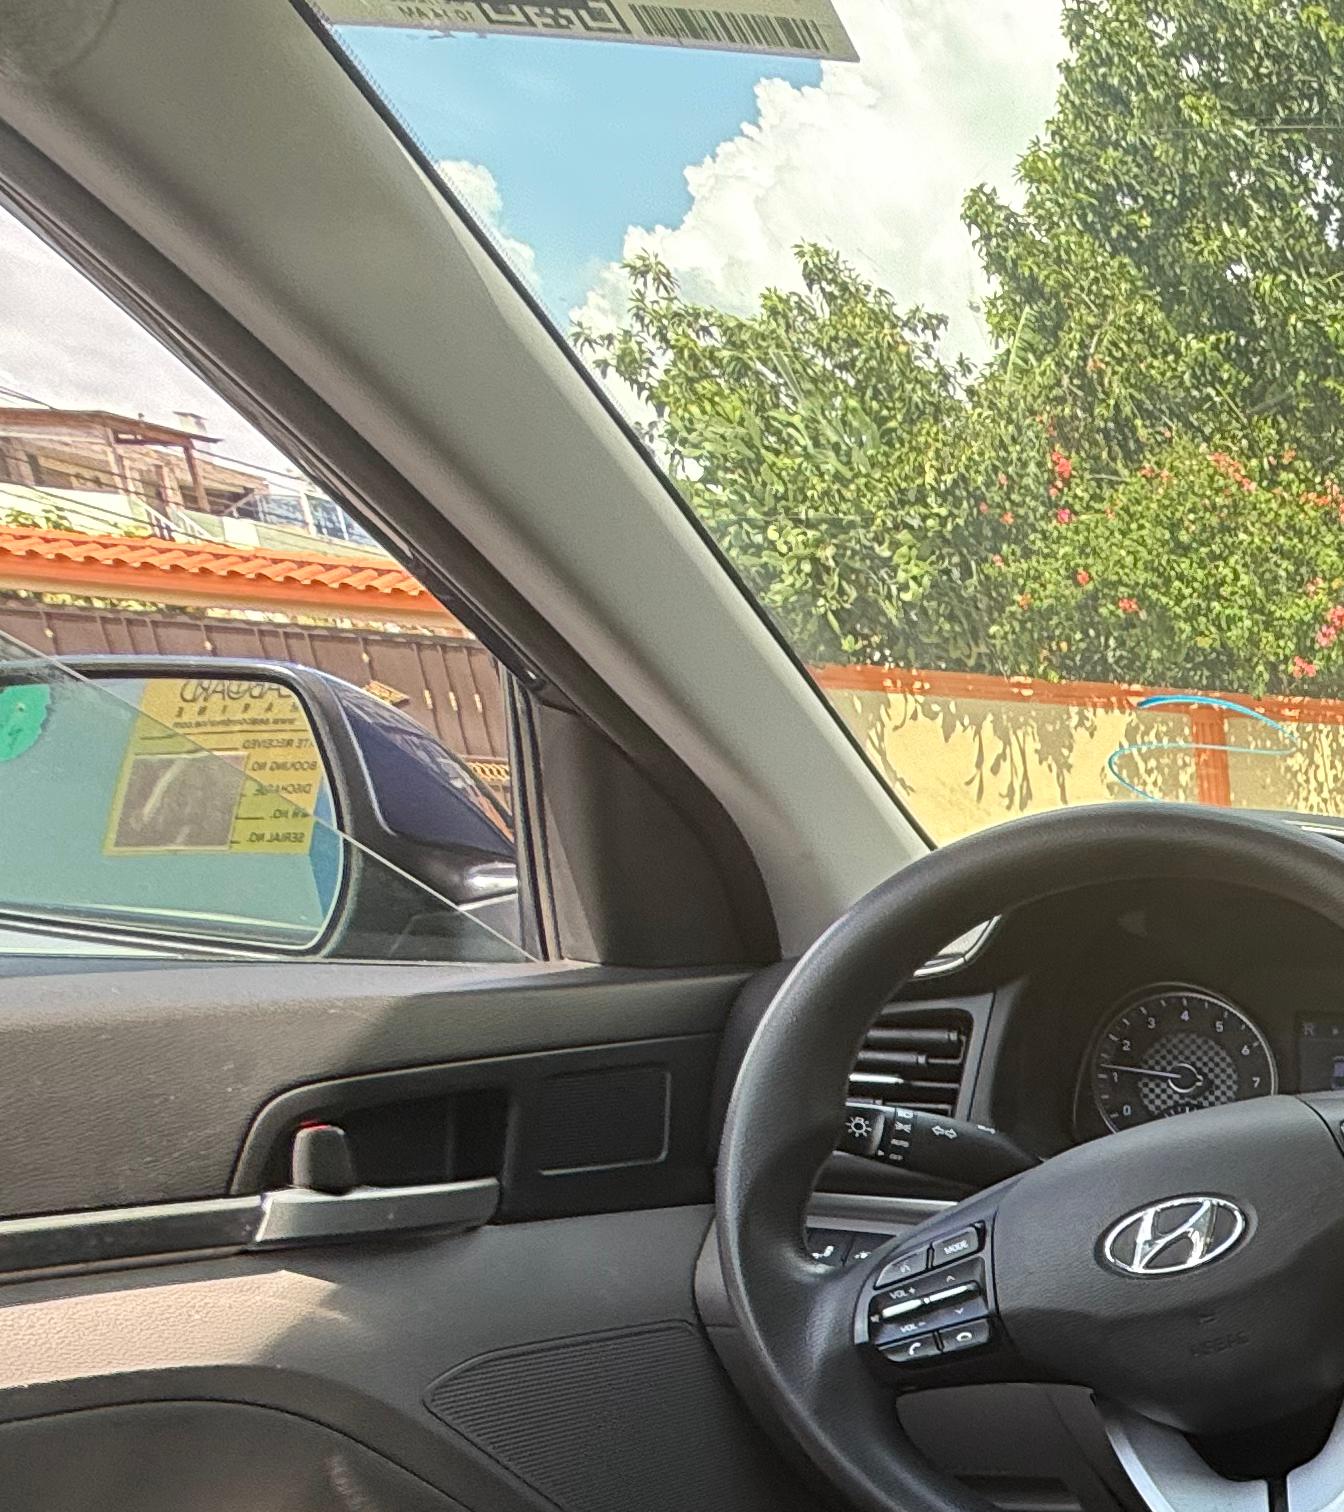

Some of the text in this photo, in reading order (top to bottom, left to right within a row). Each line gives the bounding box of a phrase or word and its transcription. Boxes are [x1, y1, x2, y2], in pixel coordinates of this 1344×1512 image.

[1180, 1010, 1190, 1021] 4
[1147, 1017, 1156, 1029] 3
[1215, 1021, 1224, 1032] 5
[1122, 1040, 1131, 1051] 2
[1241, 1045, 1250, 1056] 6
[1252, 1077, 1261, 1088] 7
[1122, 1105, 1132, 1116] 0
[943, 1240, 968, 1255] MODE
